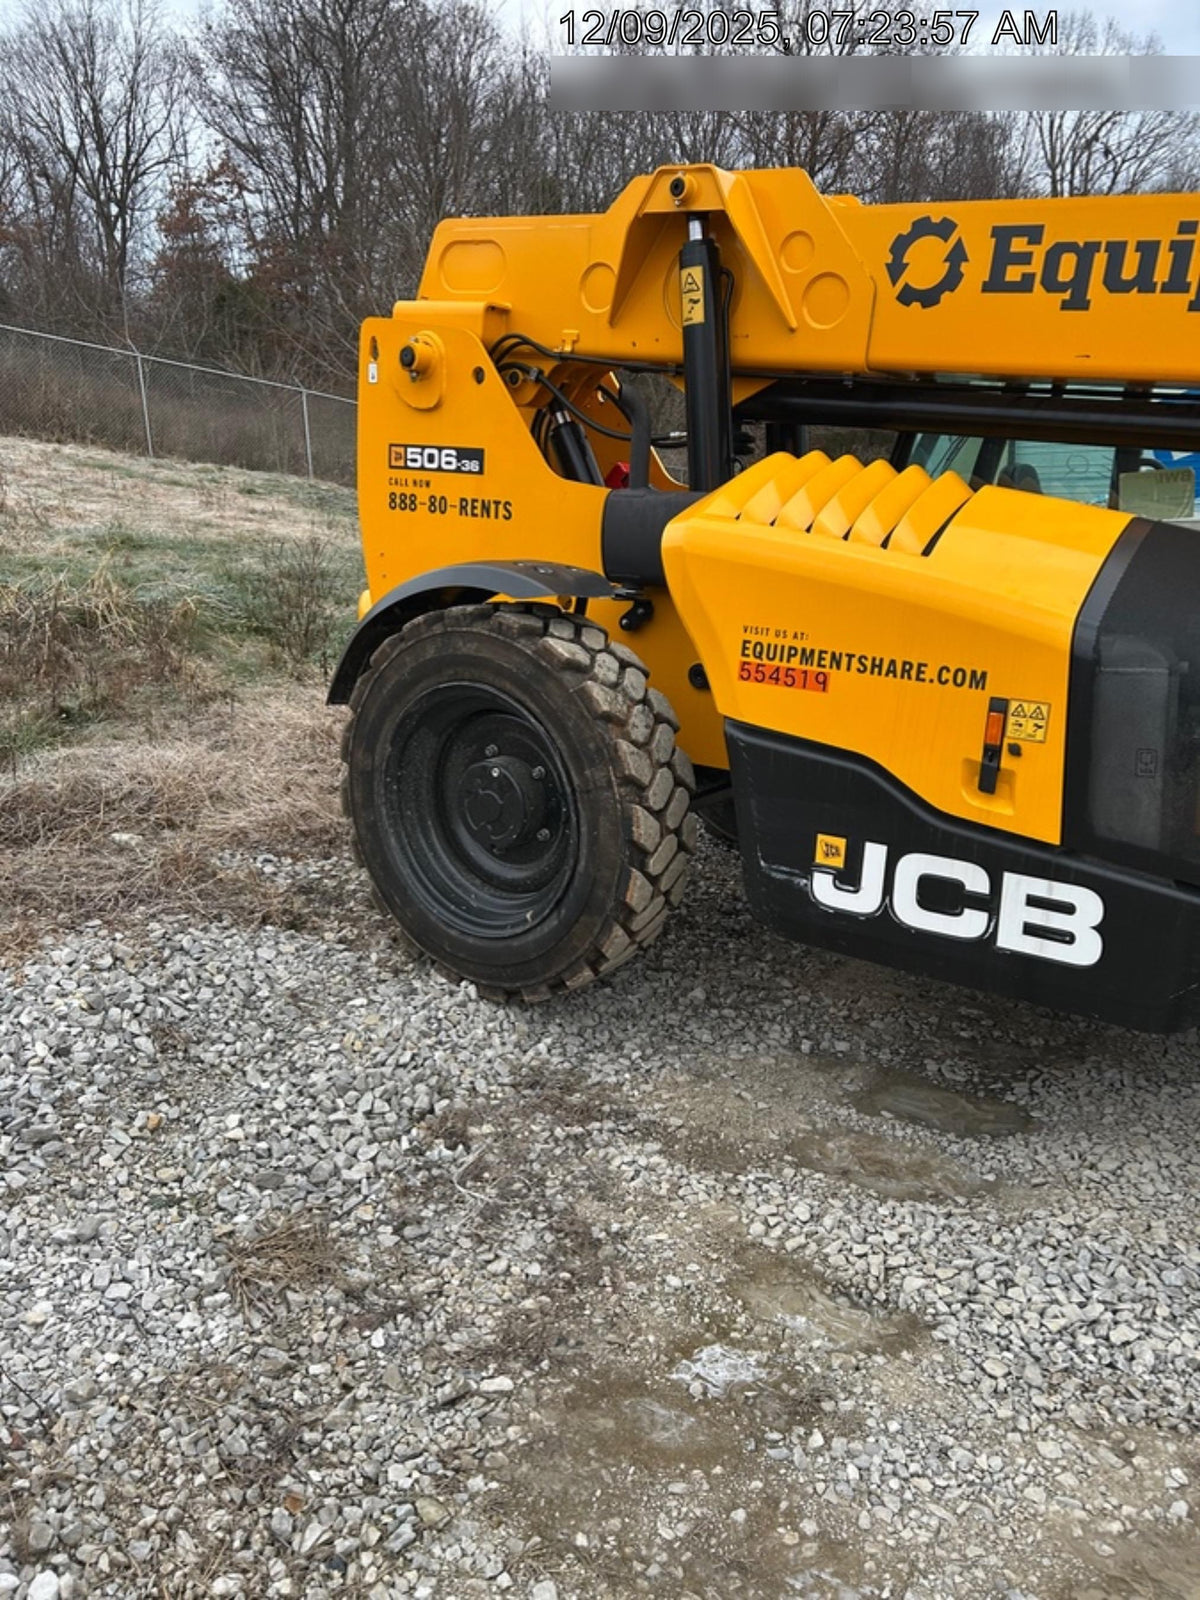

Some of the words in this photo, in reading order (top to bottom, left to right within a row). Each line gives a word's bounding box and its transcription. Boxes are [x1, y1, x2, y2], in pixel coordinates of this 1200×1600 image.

[388, 477, 409, 487] CALL
[412, 478, 431, 489] NOW
[388, 491, 513, 521] 888-80-RENTS
[743, 625, 771, 637] VISIT
[774, 628, 788, 640] US
[792, 630, 809, 642] AT:
[739, 661, 828, 693] 554519
[741, 639, 988, 691] EQUIPMENTSHARE.COM
[810, 841, 1105, 967] JCB
